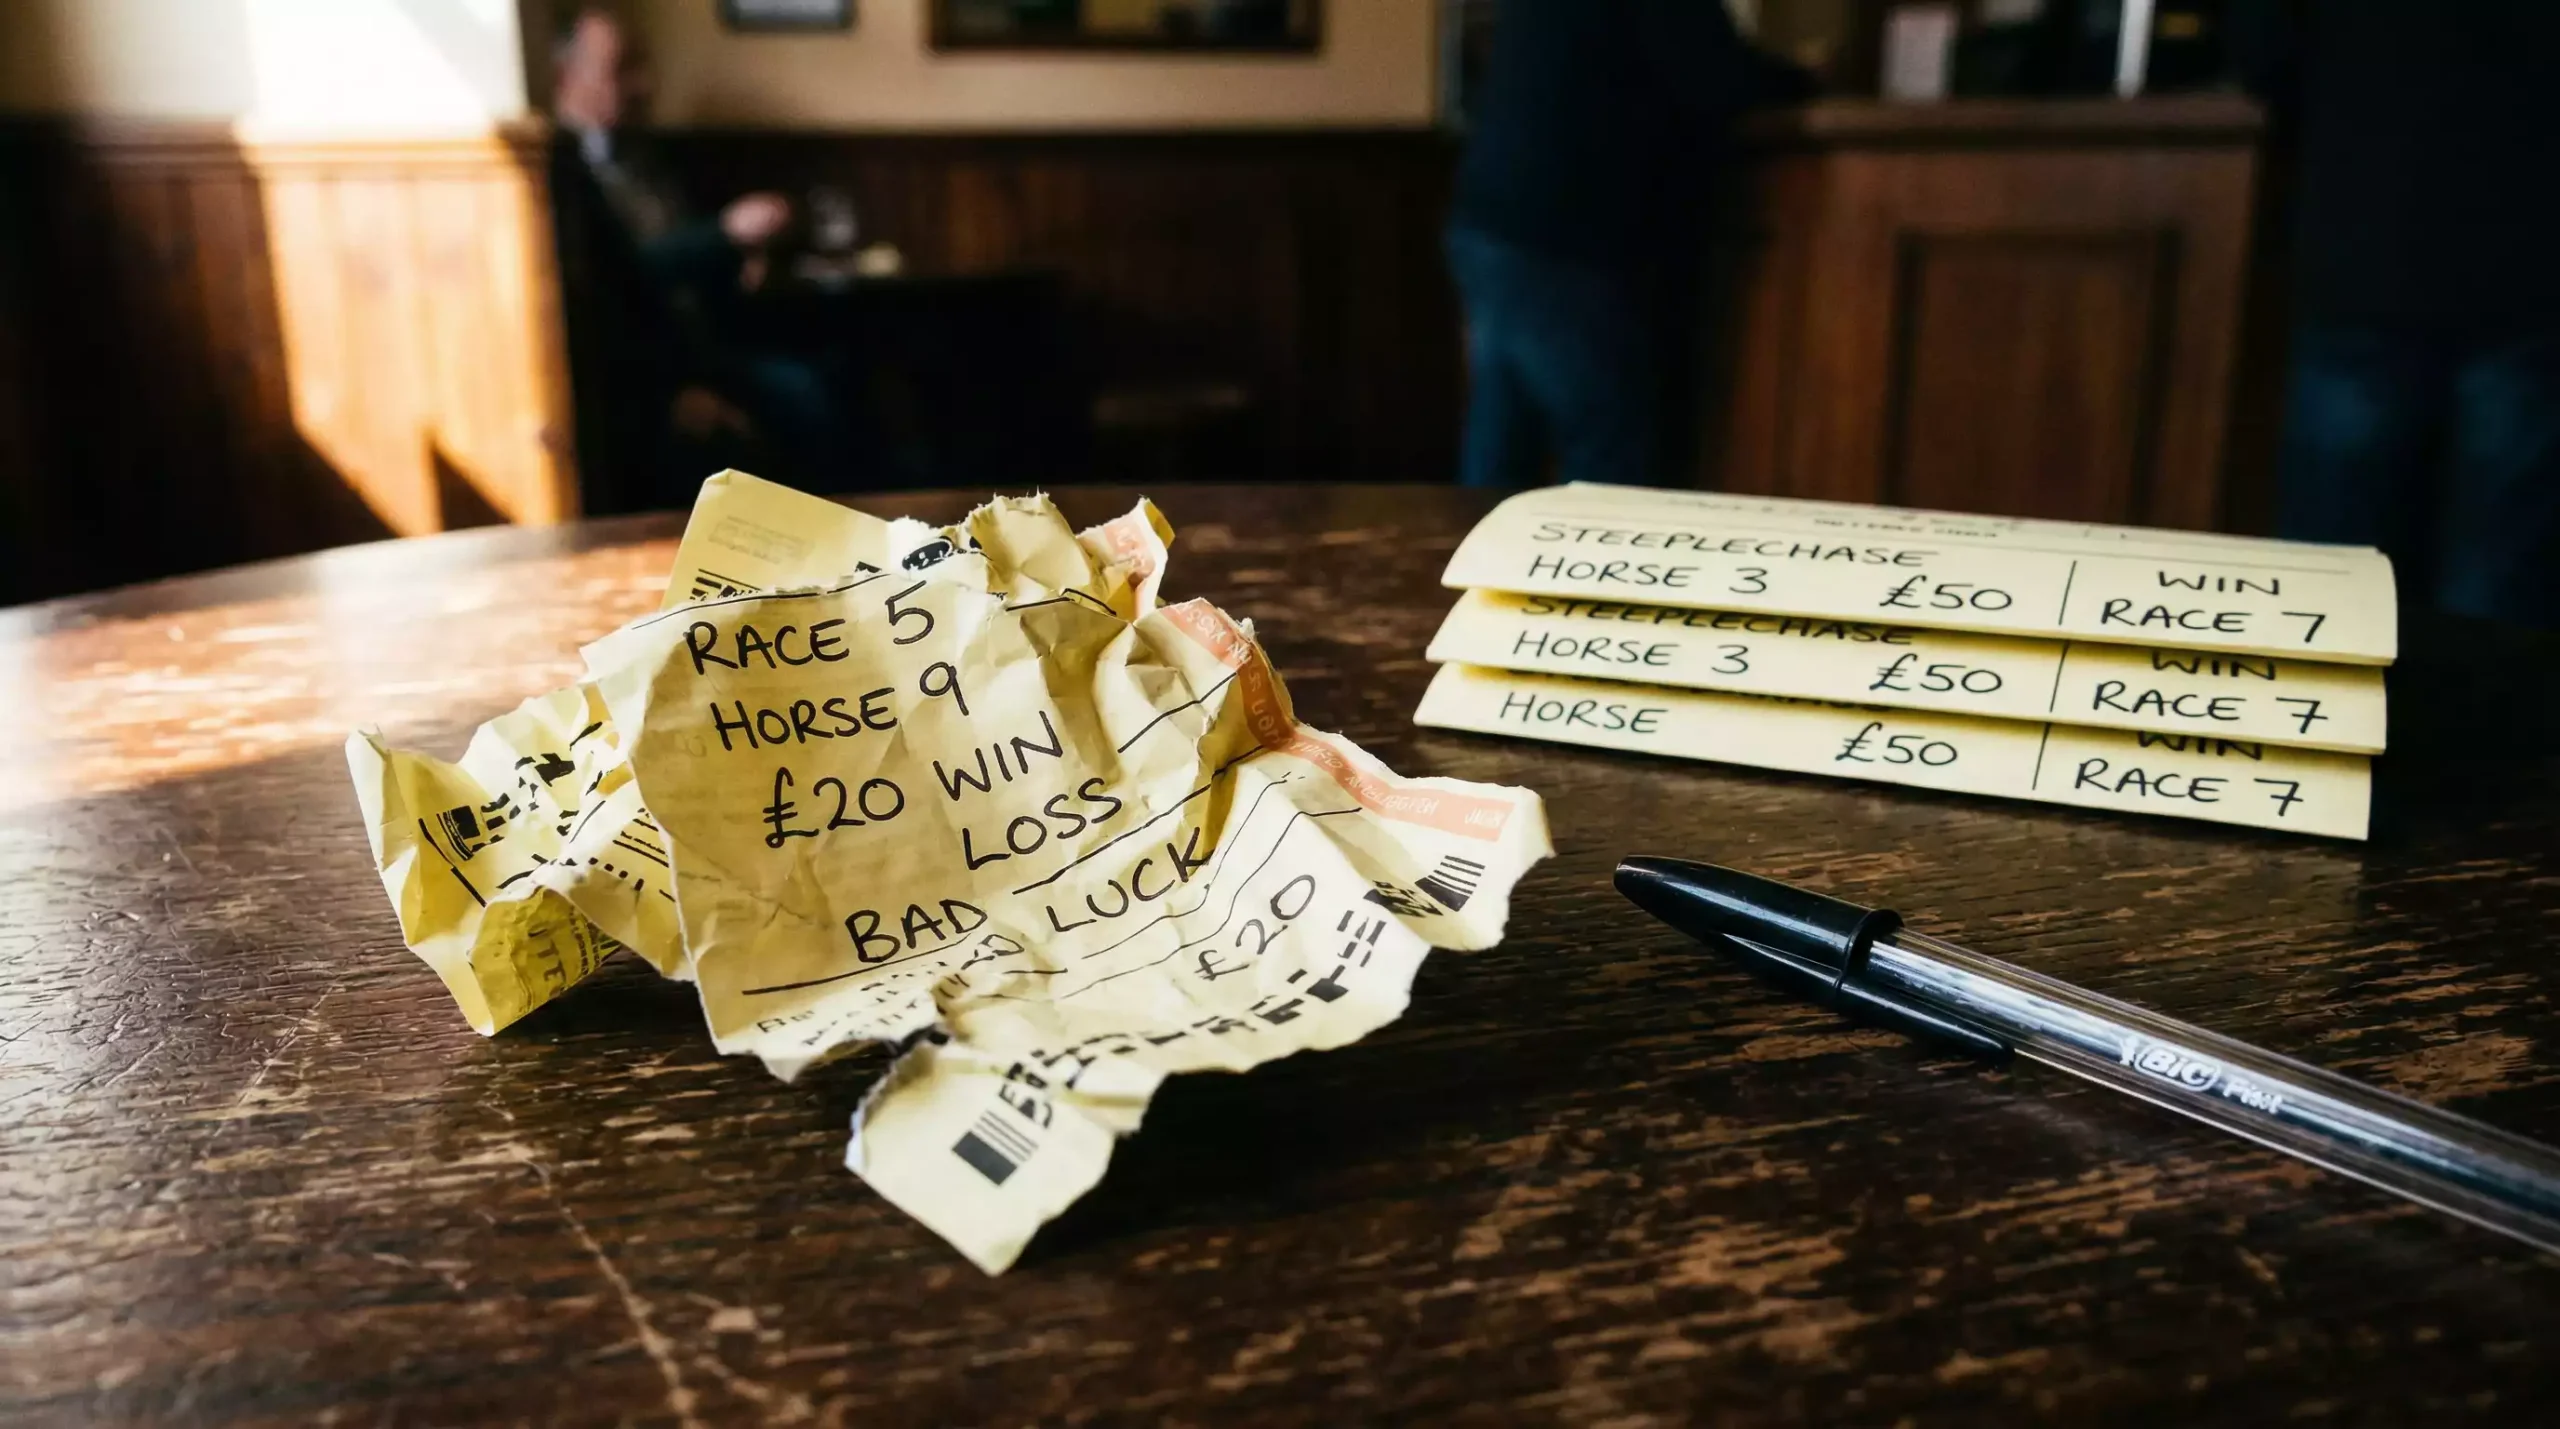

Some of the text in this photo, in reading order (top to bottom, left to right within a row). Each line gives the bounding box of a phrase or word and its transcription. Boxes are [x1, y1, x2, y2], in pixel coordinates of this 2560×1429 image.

[1532, 523, 1939, 568] STEEPLECHASE
[1528, 555, 2012, 610] HORSE 3 £50
[2158, 571, 2280, 596] WIN
[686, 580, 934, 675] RACE 5
[2101, 598, 2327, 643] RACE 7
[1512, 629, 1681, 667] HORSE
[1711, 645, 1750, 675] 3
[1868, 652, 2002, 693] £50
[2152, 651, 2276, 681] WIN
[711, 661, 969, 752] HORSE 9
[1500, 691, 1669, 734] HORSE
[1836, 722, 1958, 767] £50
[2092, 680, 2328, 734] RACE 7
[764, 710, 1064, 849] £20 WIN
[2075, 757, 2304, 818] RACE 7
[962, 777, 1122, 870] LOSS
[845, 899, 987, 963] BAD
[1046, 826, 1214, 933] LUCK
[1195, 874, 1317, 982] £20
